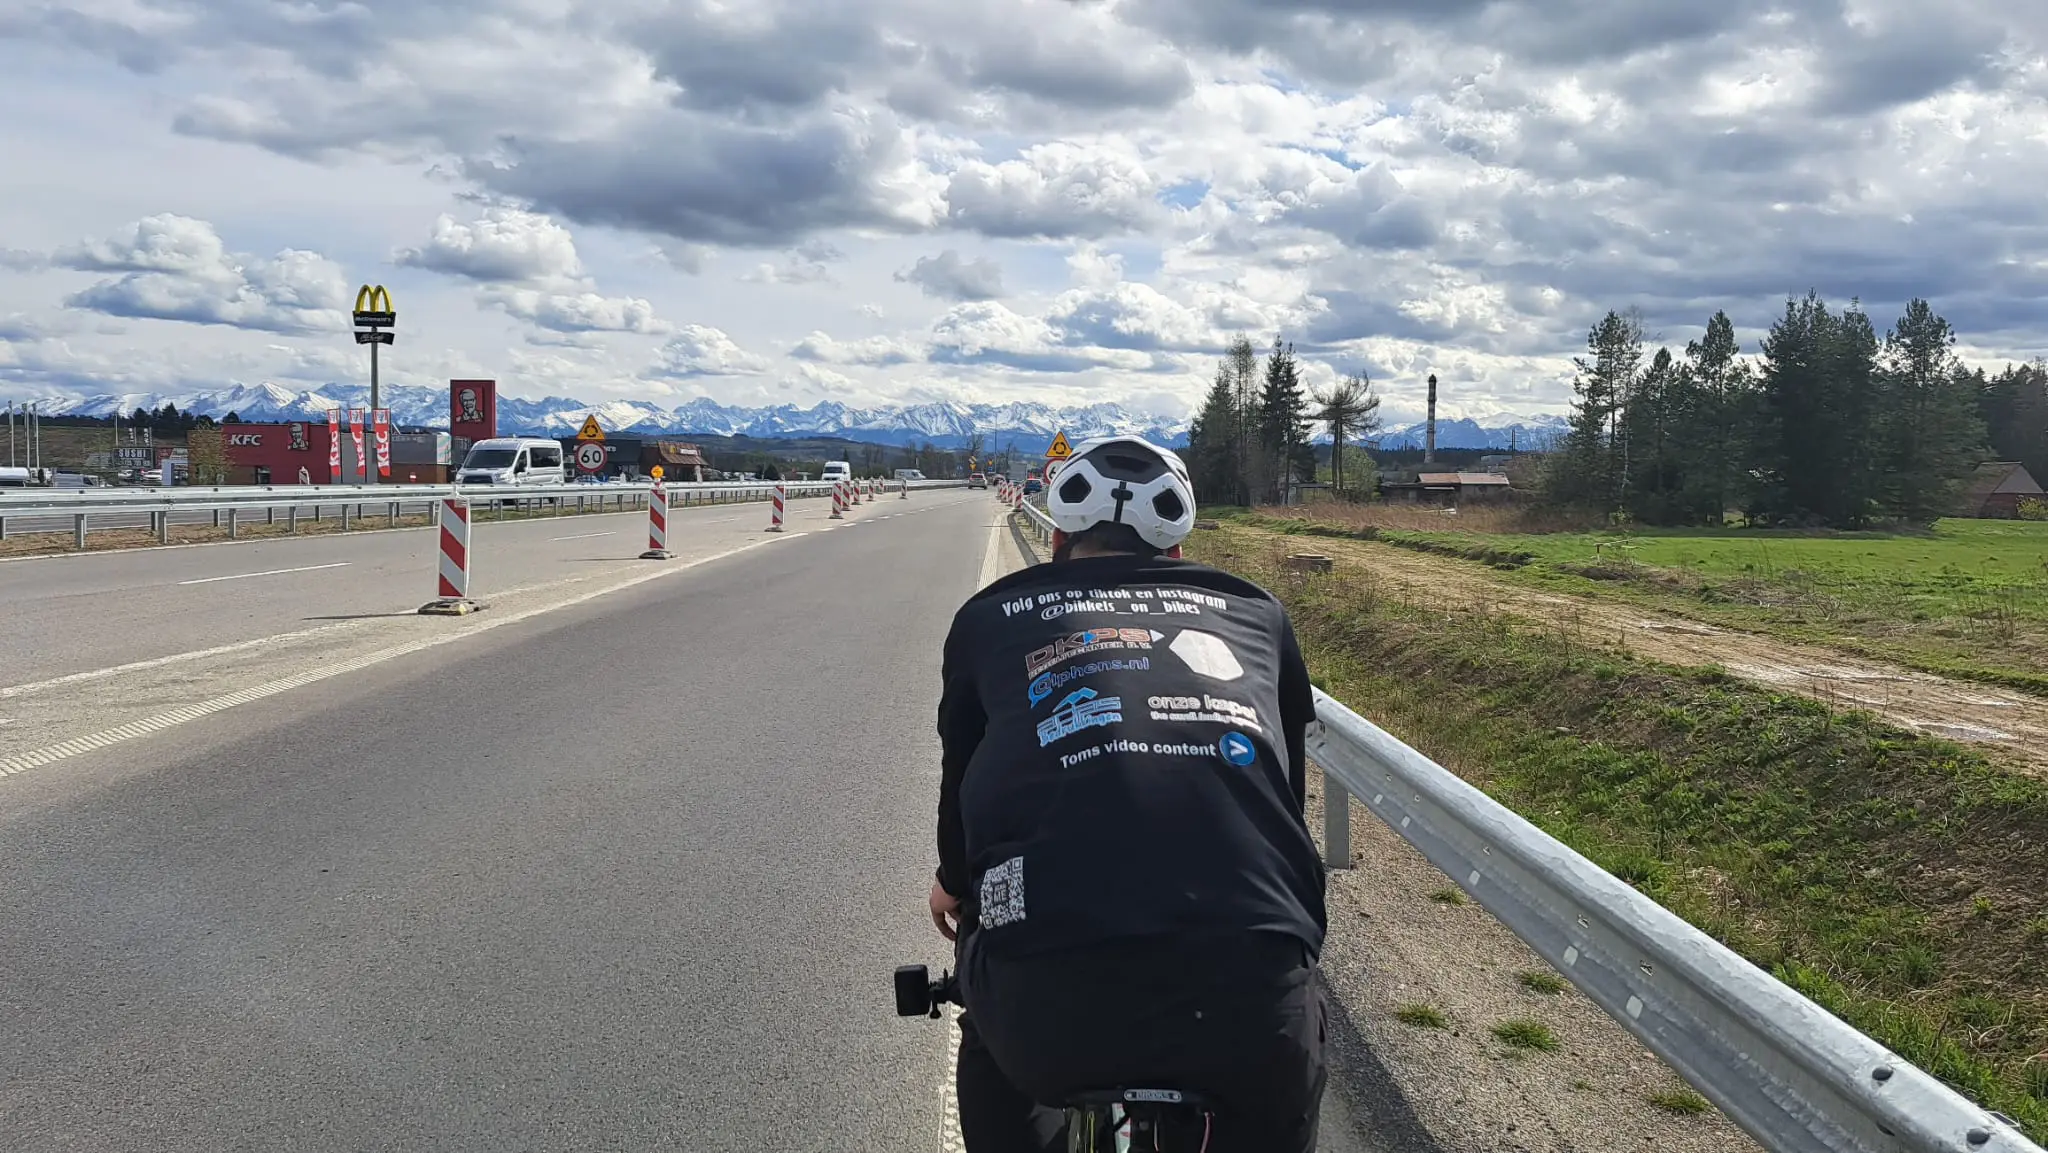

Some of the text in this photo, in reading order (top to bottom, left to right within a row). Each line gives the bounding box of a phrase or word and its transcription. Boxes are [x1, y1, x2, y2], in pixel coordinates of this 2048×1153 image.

[118, 448, 146, 458] SUSHI
[230, 434, 262, 446] KFC
[329, 431, 340, 466] KFC
[352, 431, 365, 468] KFC
[376, 431, 390, 468] KFC
[581, 450, 602, 463] 60
[1002, 588, 1227, 617] Volg ons op tiktok en instagram
[1148, 695, 1201, 710] onze
[1060, 739, 1217, 769] Toms video content
